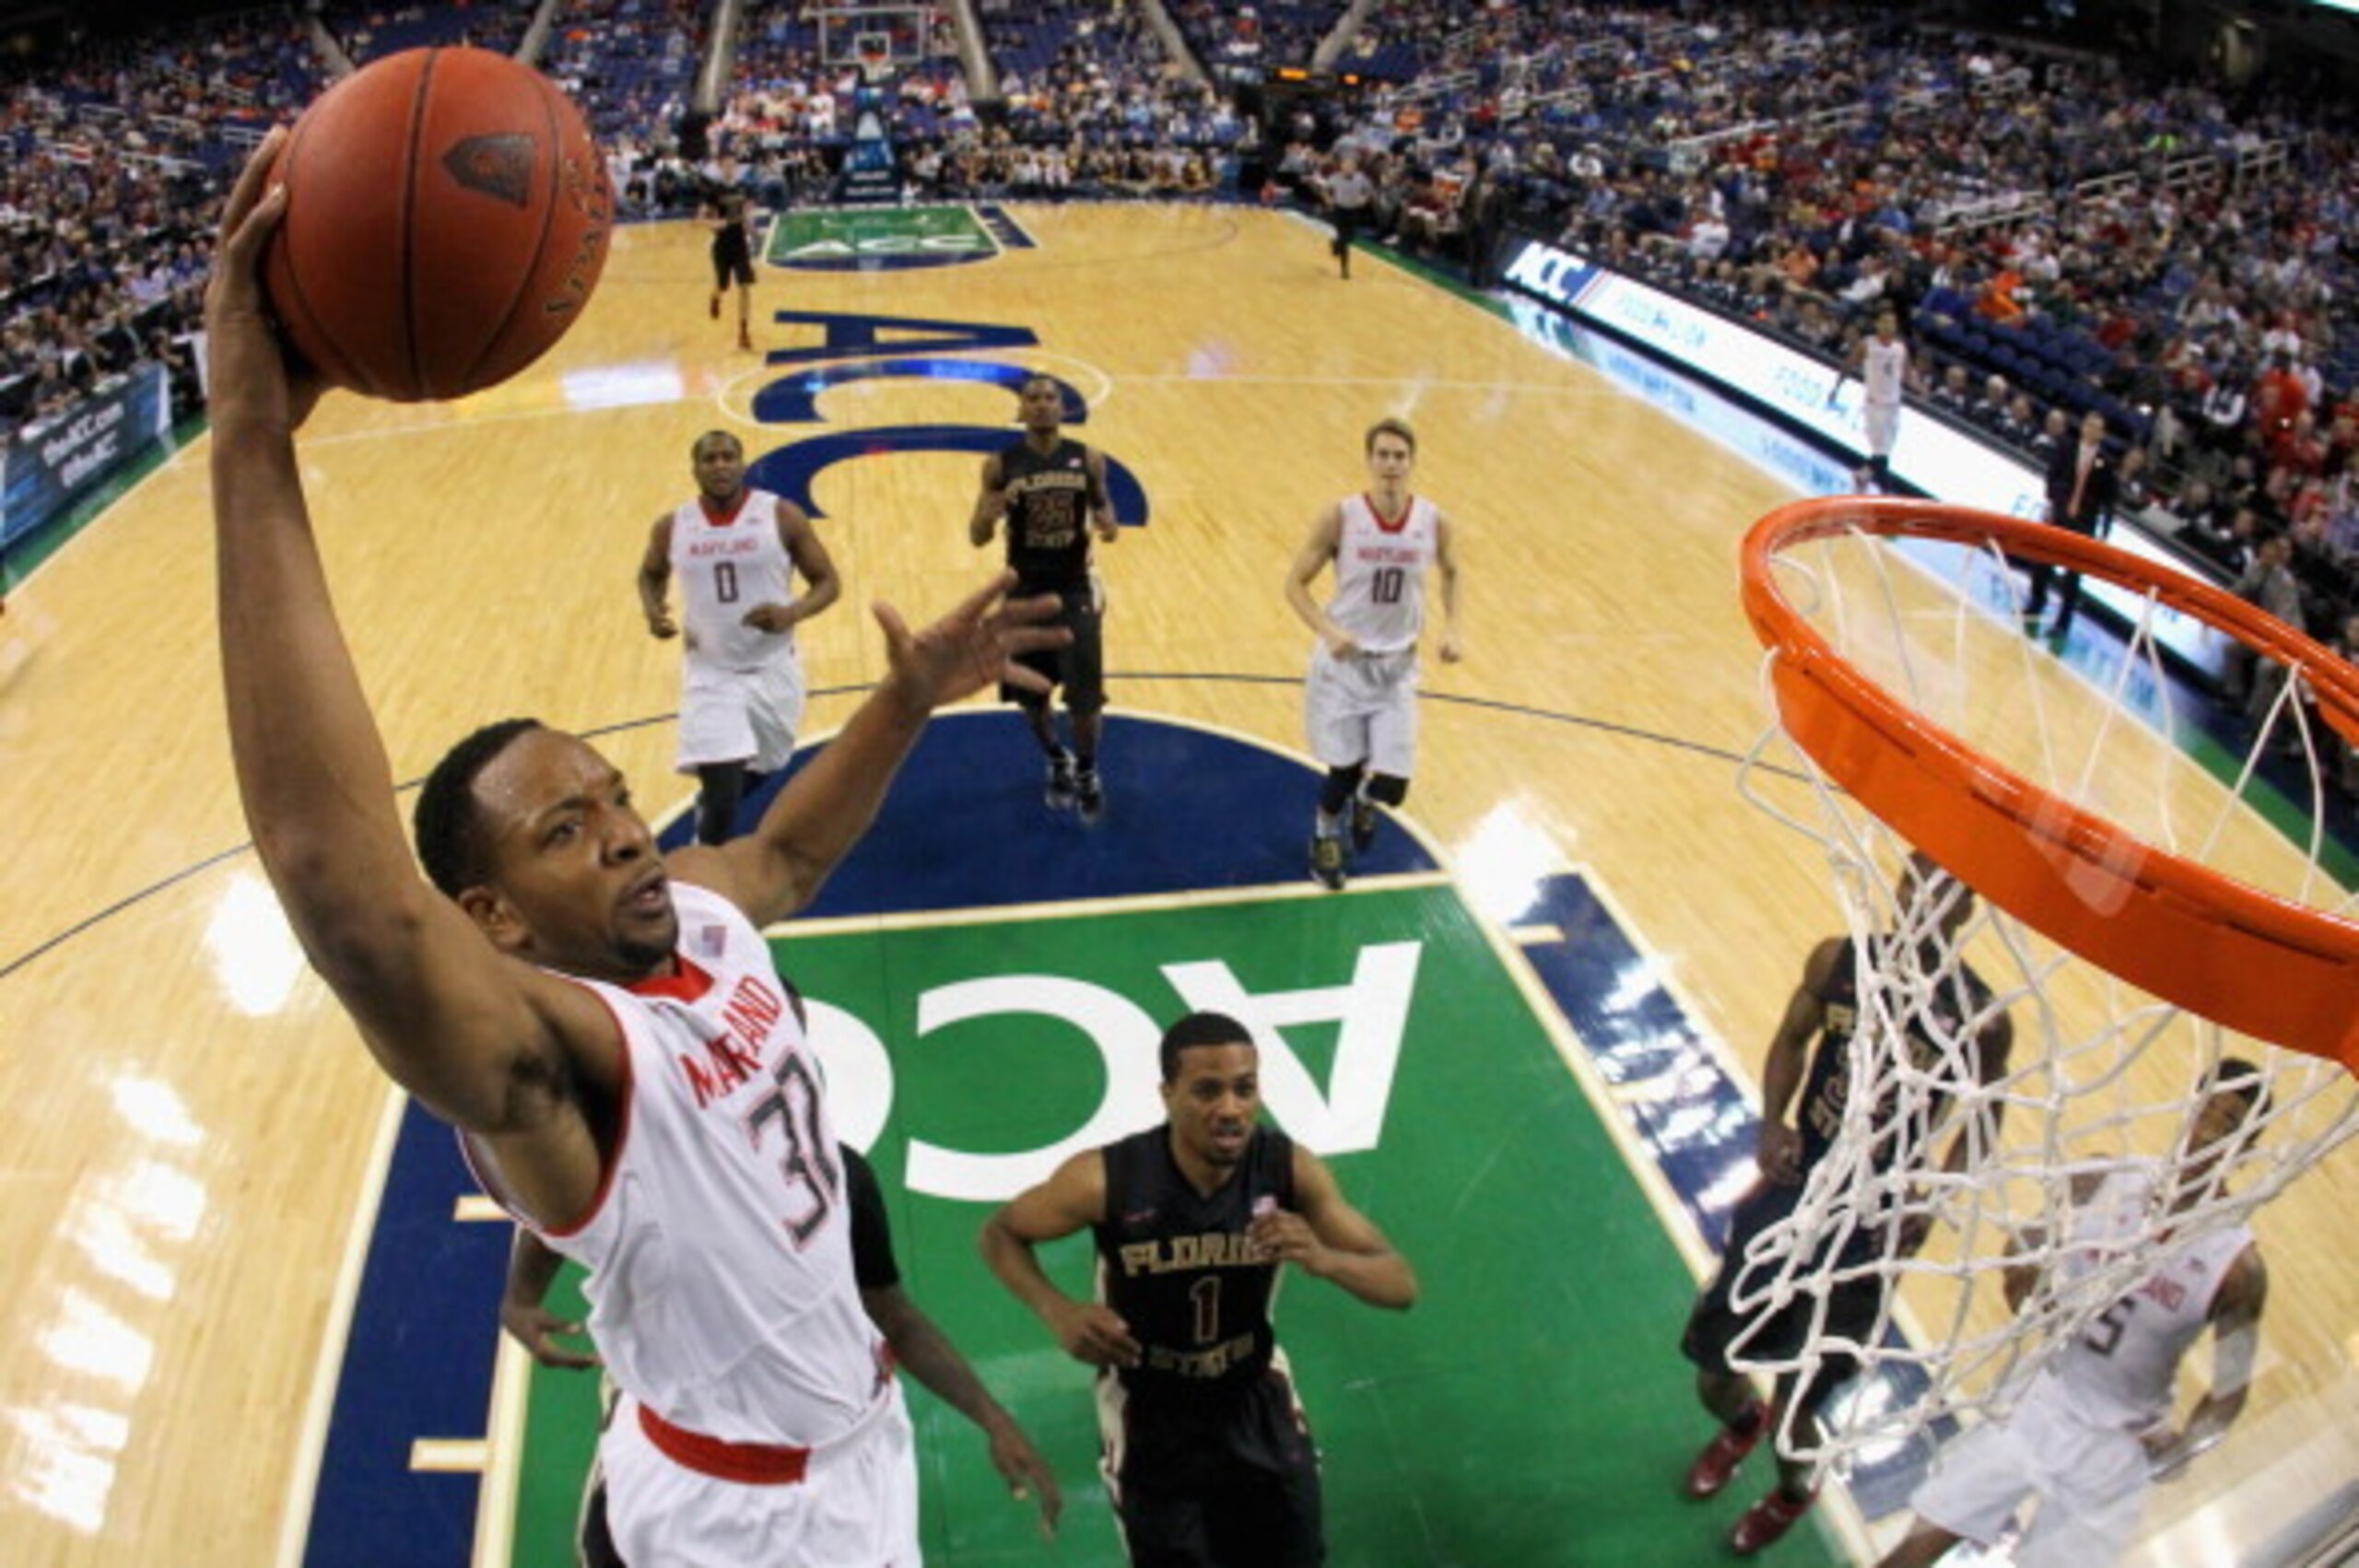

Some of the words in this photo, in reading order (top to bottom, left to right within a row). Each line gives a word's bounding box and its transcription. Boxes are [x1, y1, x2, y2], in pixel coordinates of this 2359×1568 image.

[784, 234, 979, 257] ACC
[1504, 240, 1587, 301] ACC
[714, 562, 739, 603] 0
[1372, 568, 1404, 603] 10
[797, 942, 1422, 1201] AC
[1119, 1232, 1257, 1278] FLORI
[1190, 1275, 1221, 1343] 1
